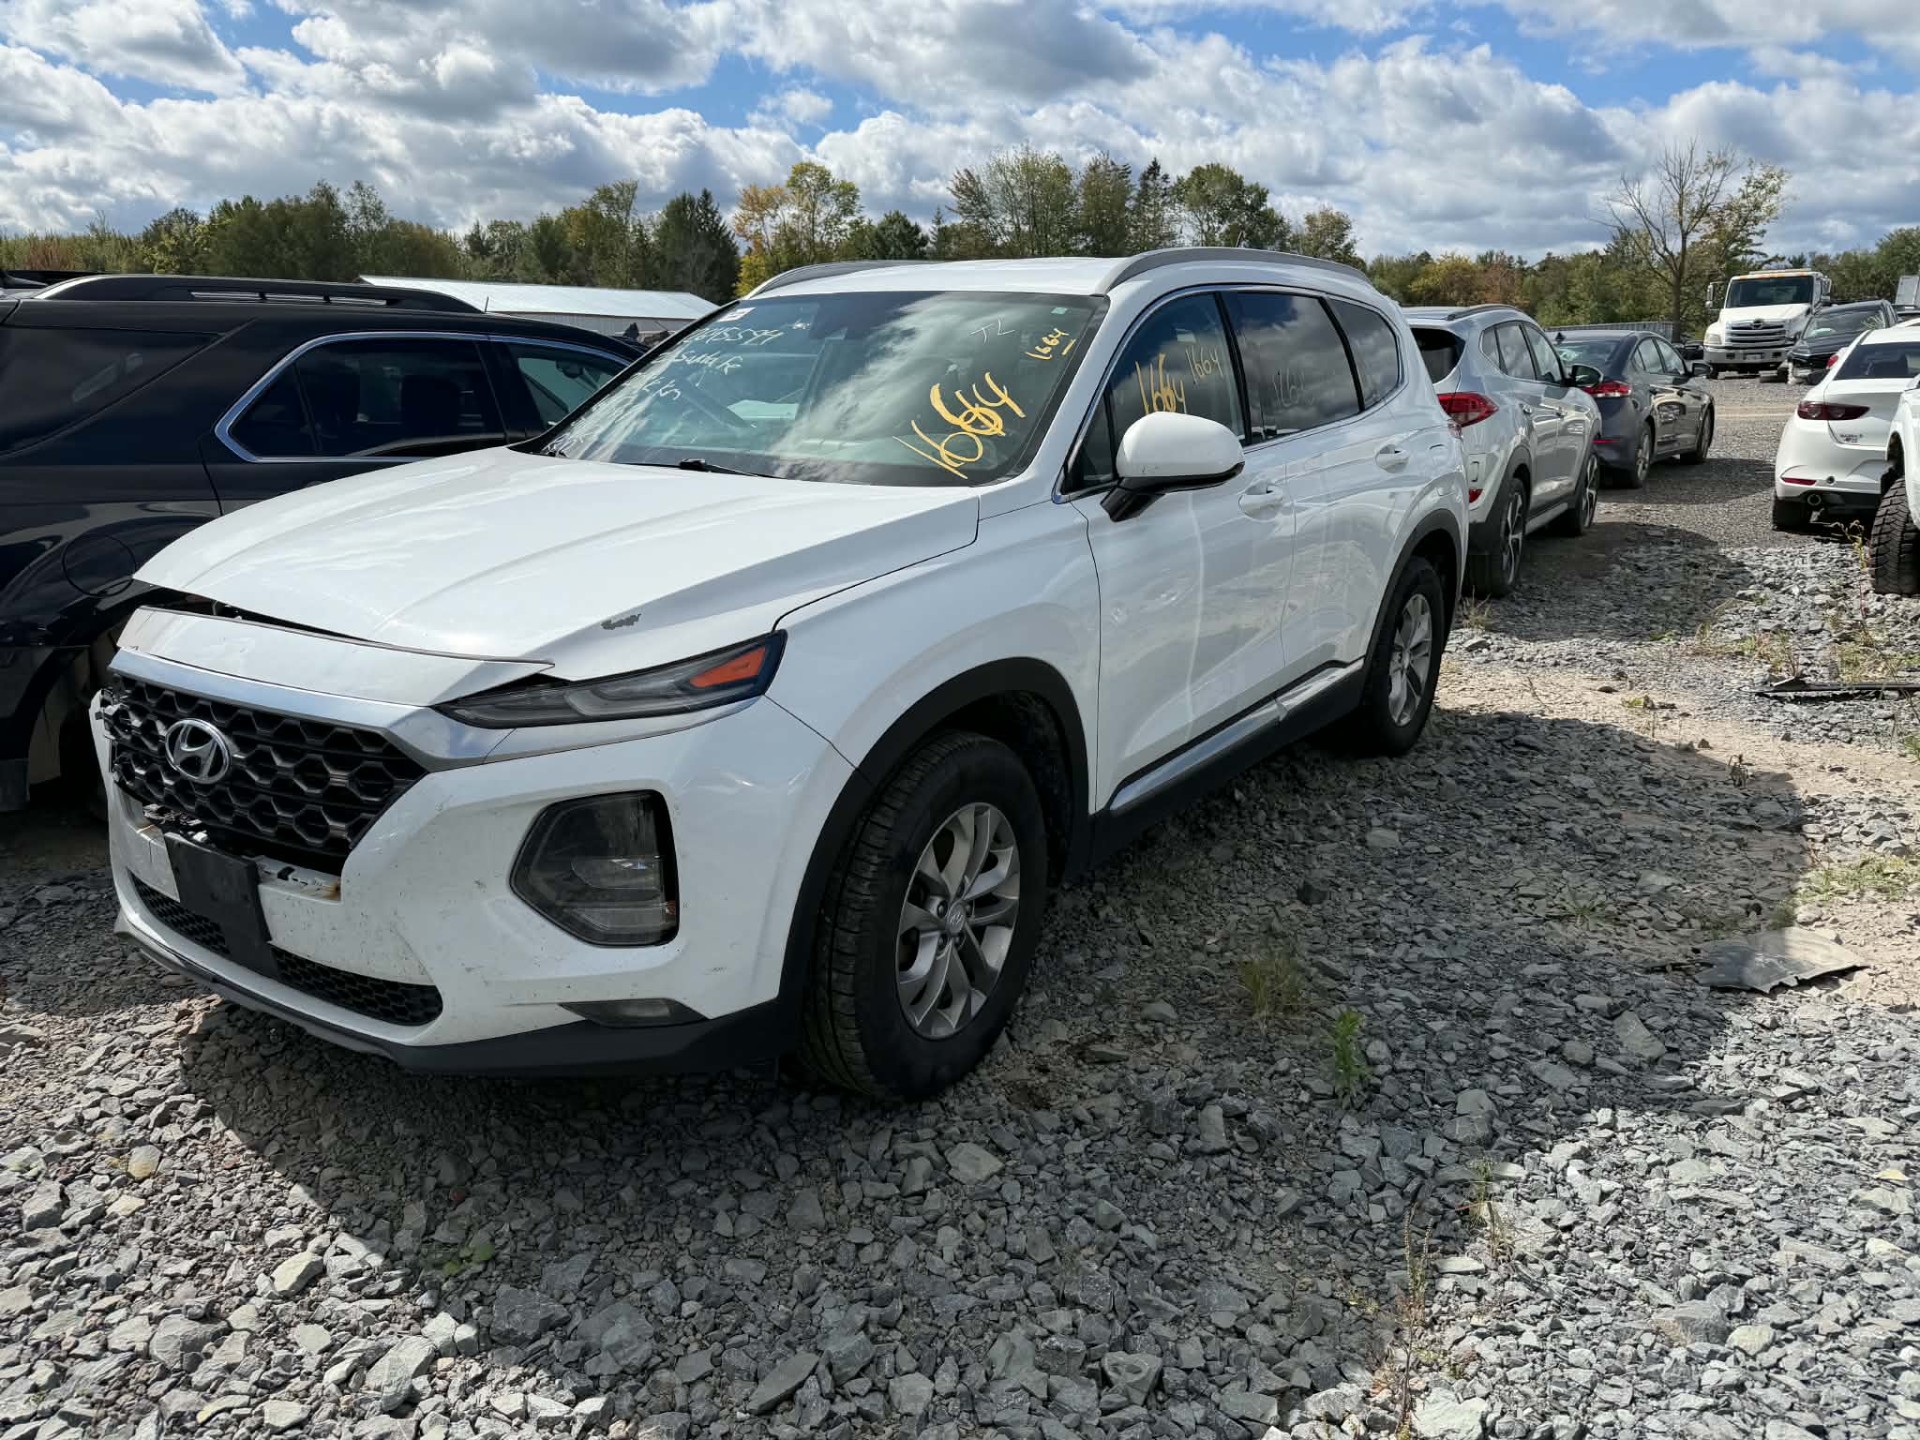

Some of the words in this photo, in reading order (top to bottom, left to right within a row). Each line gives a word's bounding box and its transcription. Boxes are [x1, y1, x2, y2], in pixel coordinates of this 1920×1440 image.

[1024, 327, 1070, 360] 1664
[1185, 346, 1224, 385] 1664
[1135, 353, 1187, 414] 1664
[892, 371, 1026, 479] 1664
